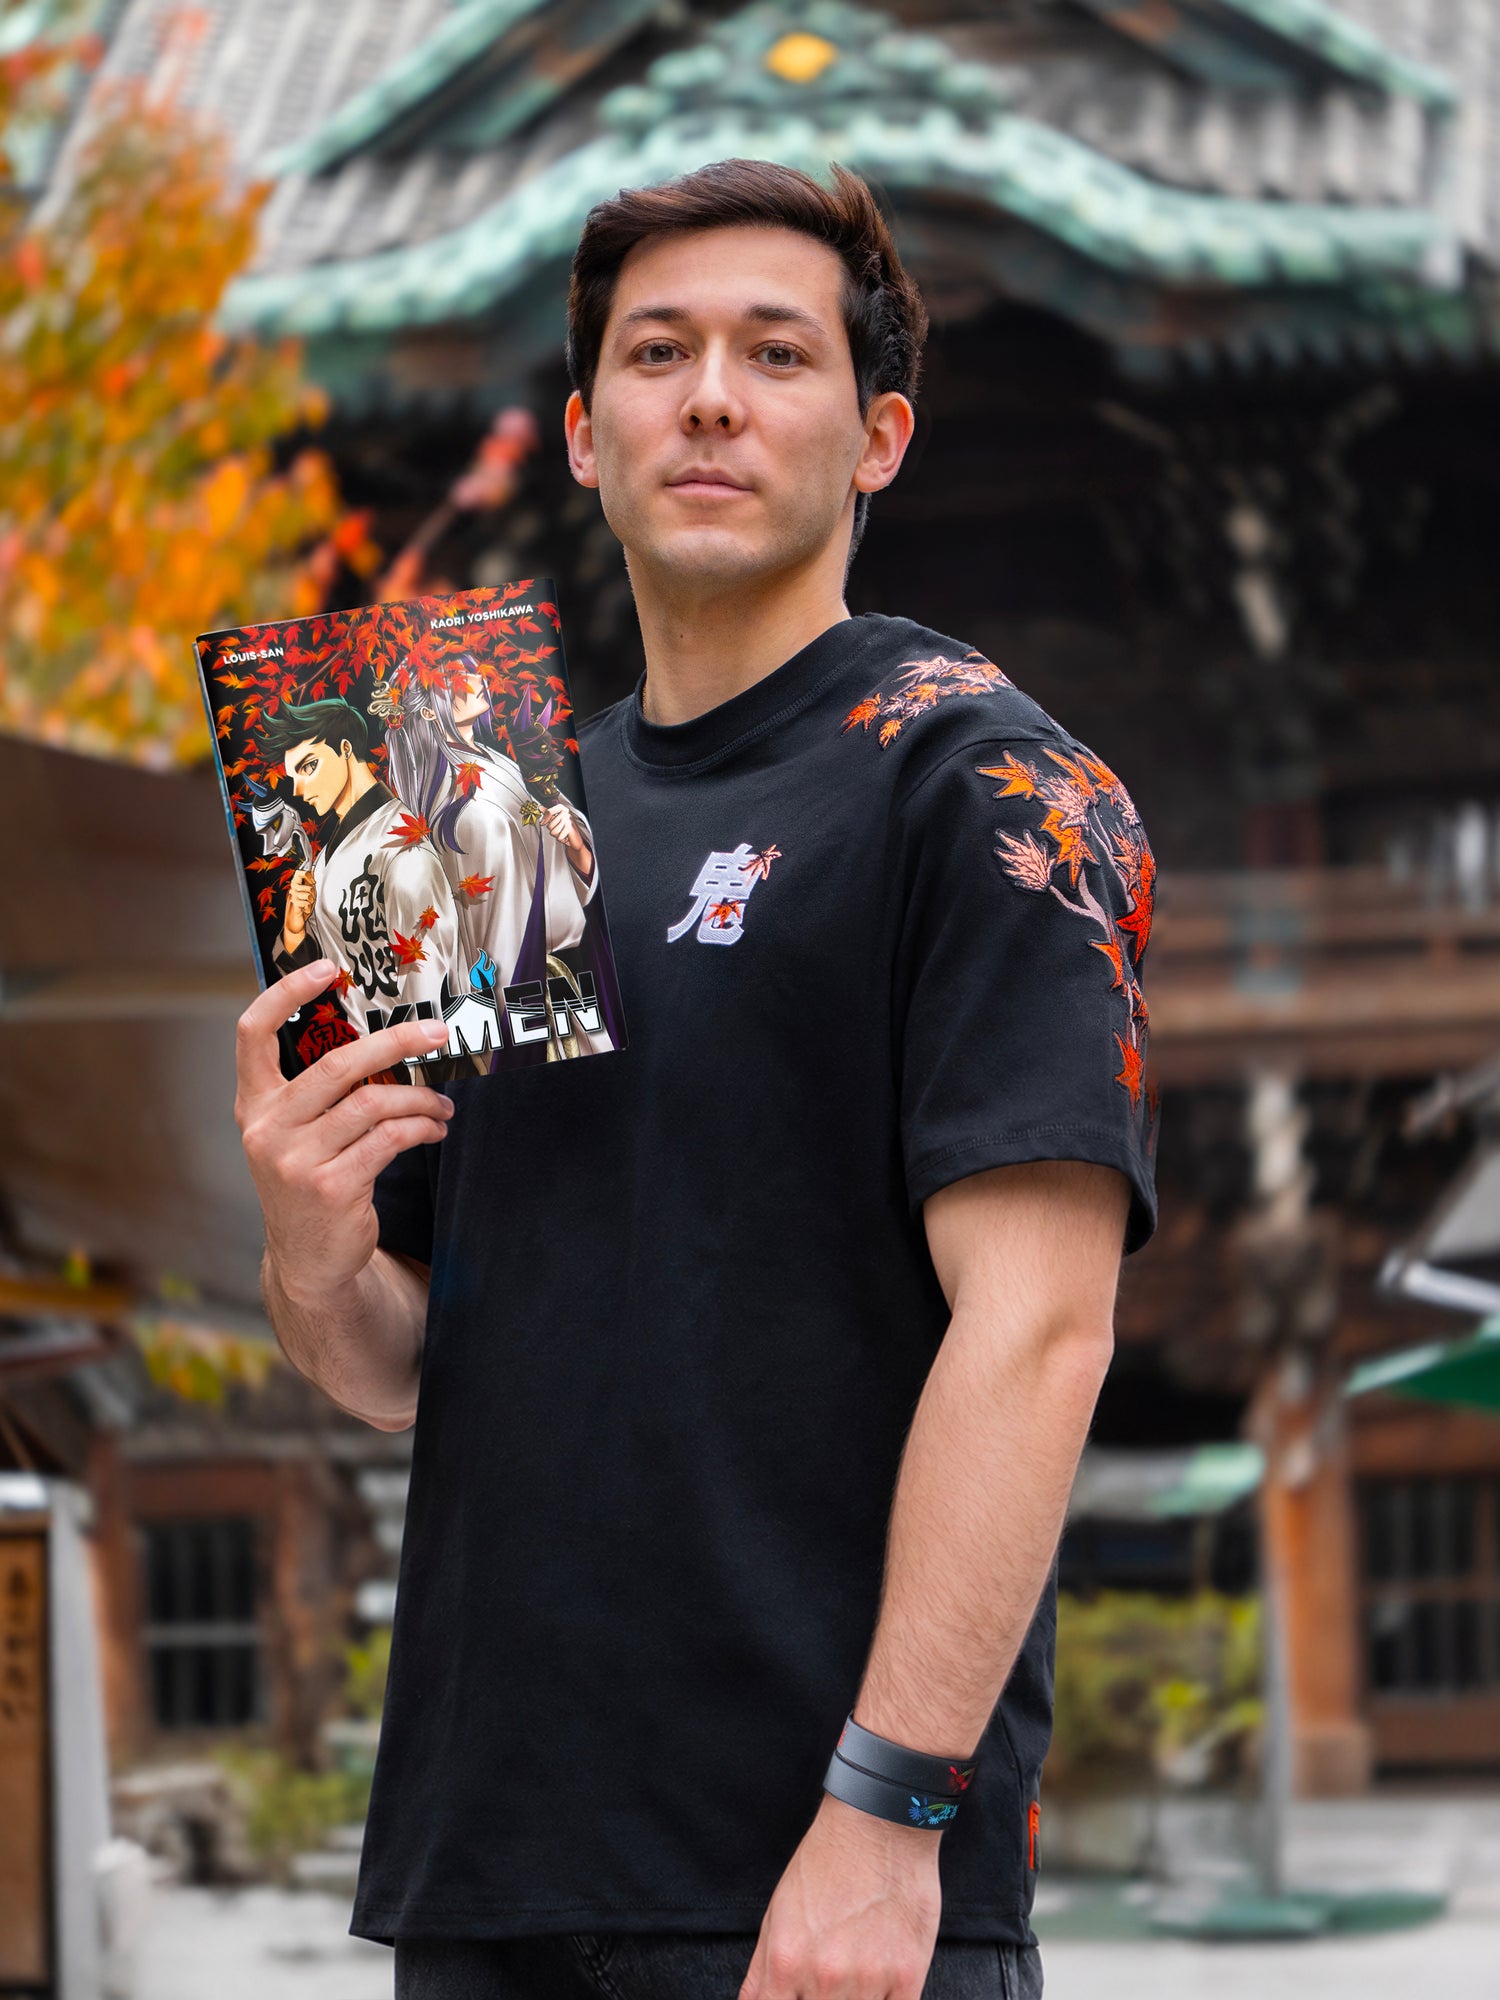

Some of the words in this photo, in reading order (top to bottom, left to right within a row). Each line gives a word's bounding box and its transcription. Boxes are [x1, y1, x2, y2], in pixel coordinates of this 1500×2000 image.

[430, 616, 465, 629] KAORI
[467, 604, 534, 623] YOSHIKAWA
[223, 647, 284, 664] LOUIS-SAN
